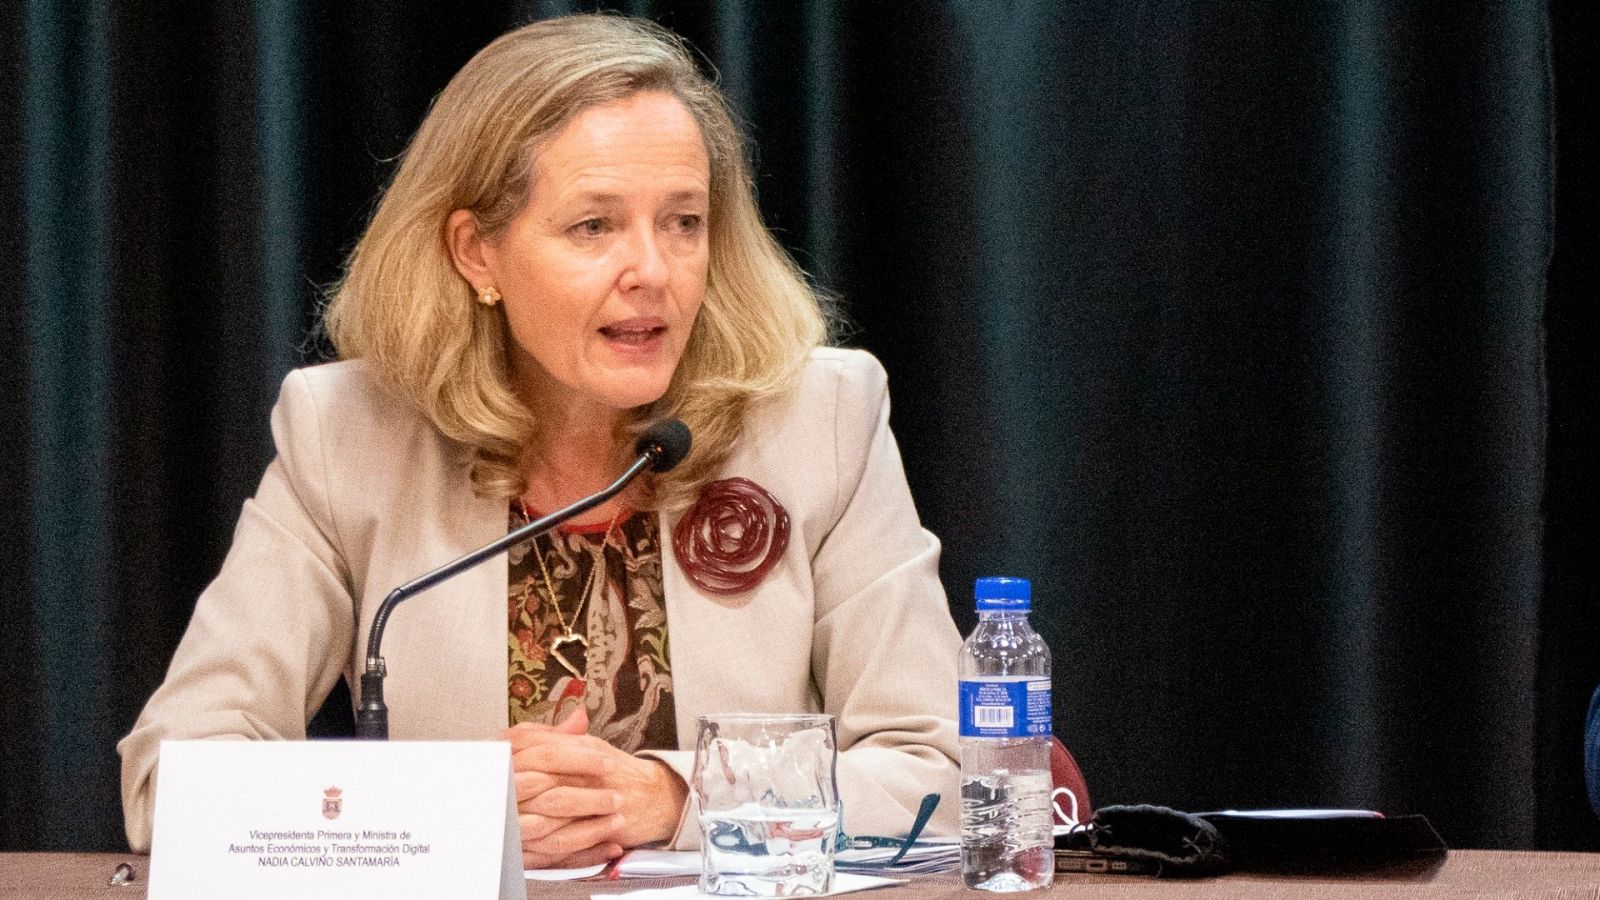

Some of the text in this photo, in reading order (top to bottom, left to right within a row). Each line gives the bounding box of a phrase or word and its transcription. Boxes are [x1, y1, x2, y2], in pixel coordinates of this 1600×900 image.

[249, 830, 411, 843] Vicepresidenta Primera y Ministra de
[228, 844, 430, 857] Asuntos Económicos y Transformación Digital
[258, 857, 290, 867] NADIA
[336, 855, 400, 867] SANTAMARÍA
